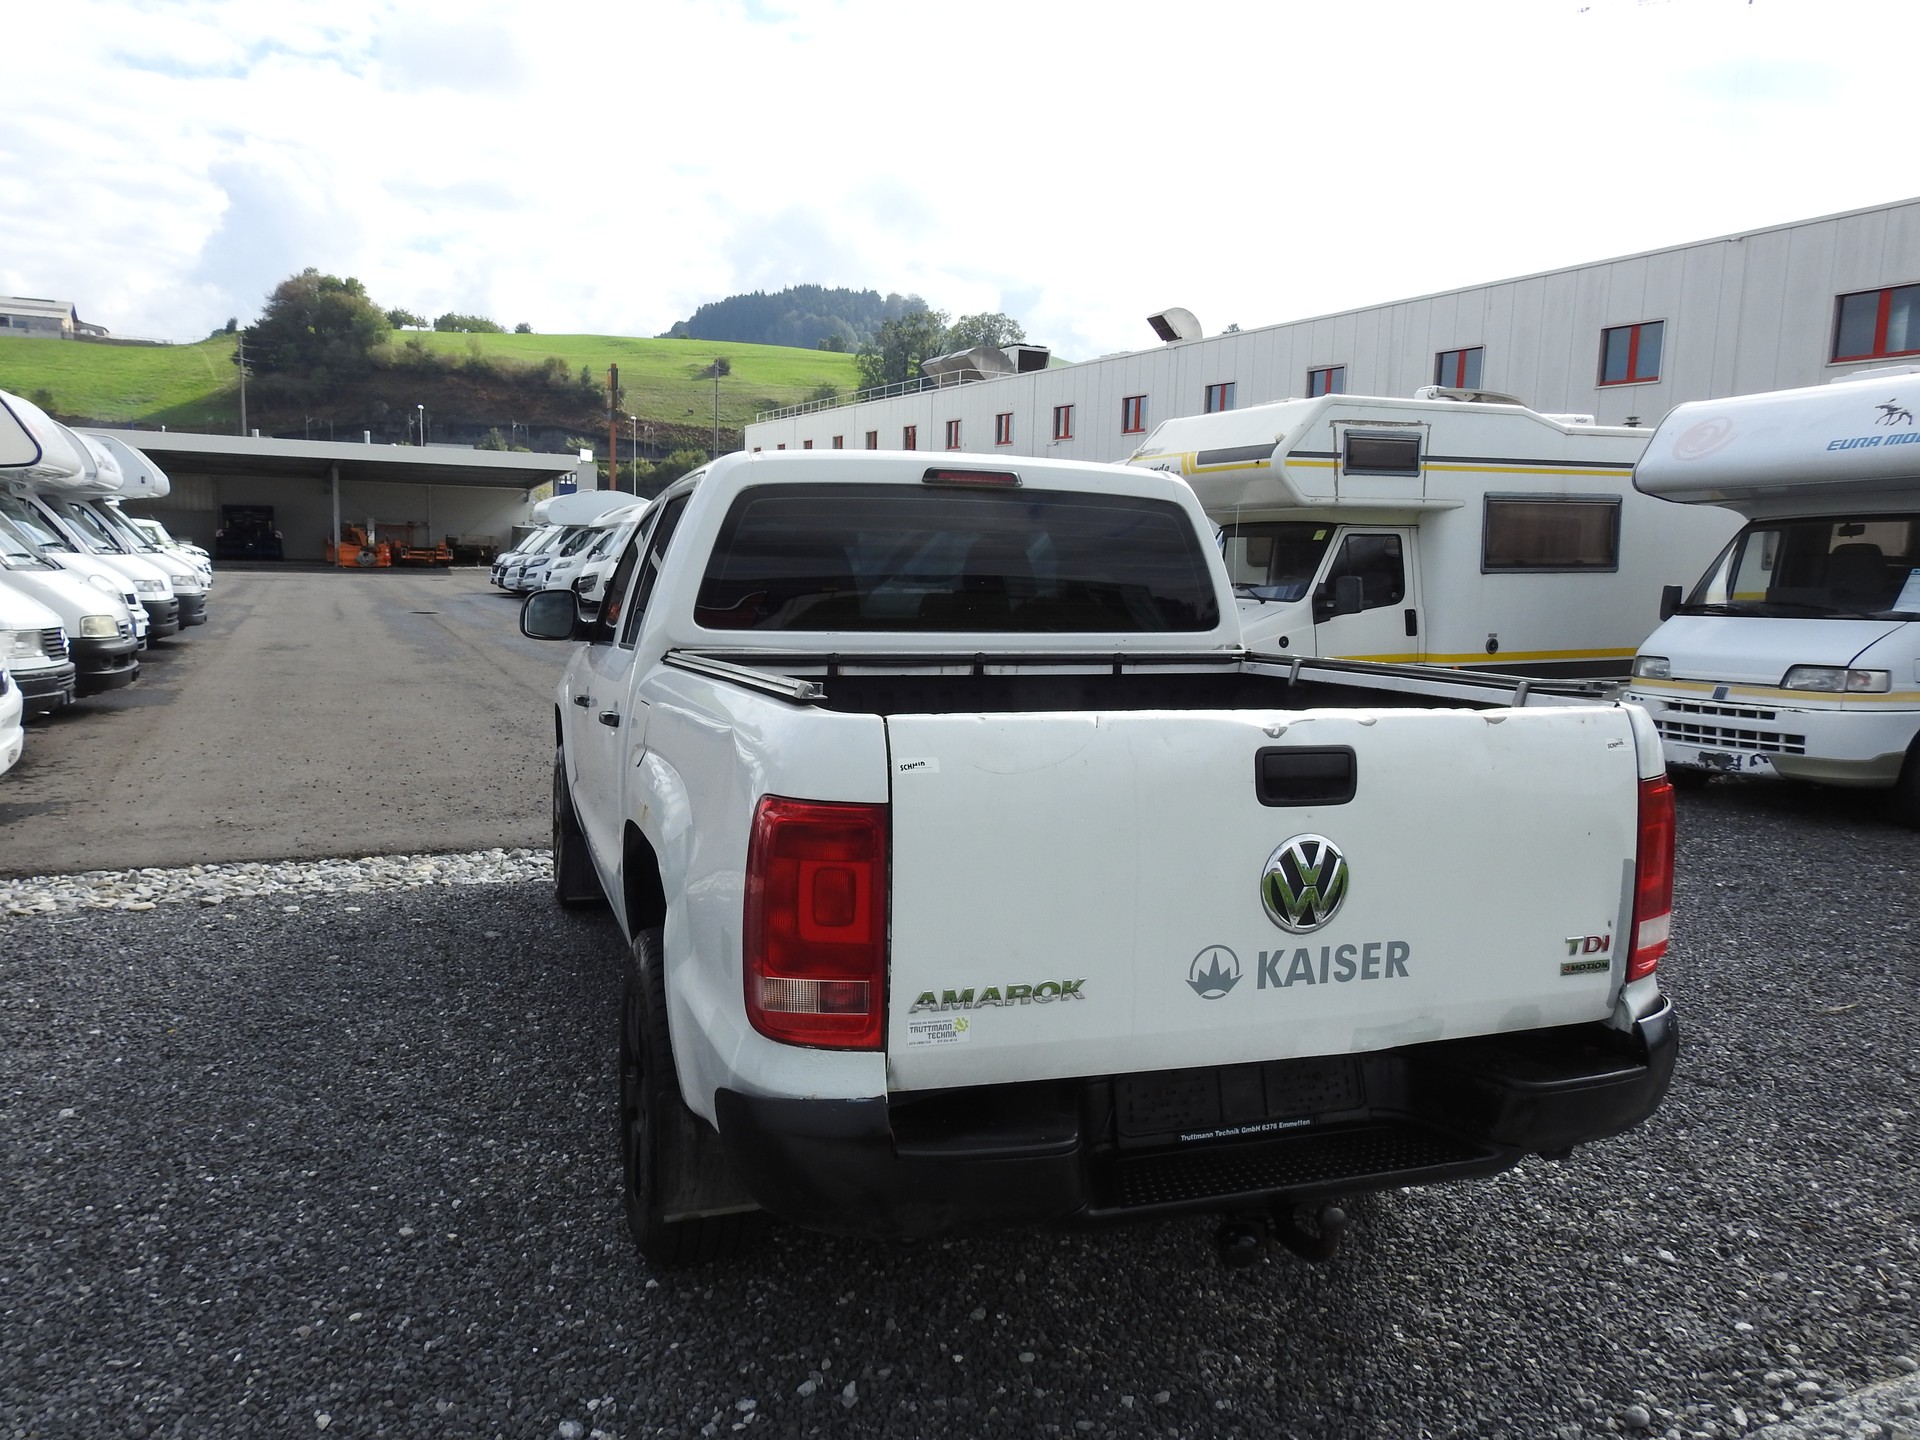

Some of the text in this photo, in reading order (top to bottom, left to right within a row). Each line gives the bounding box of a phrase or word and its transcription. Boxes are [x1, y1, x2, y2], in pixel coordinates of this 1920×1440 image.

[1826, 436, 1883, 451] EURA
[900, 761, 926, 771] SCHMID
[1260, 833, 1349, 935] VW
[1257, 940, 1411, 990] KAISER
[1563, 961, 1608, 973] 4MOTION
[908, 977, 1087, 1014] AMAROK
[909, 1023, 952, 1033] TRUTTMANN
[927, 1030, 957, 1039] TECHNIK
[1180, 1132, 1213, 1141] Truttmann
[1214, 1127, 1240, 1137] Technik
[1241, 1124, 1261, 1134] GmbH
[1279, 1119, 1311, 1129] Emmetten
